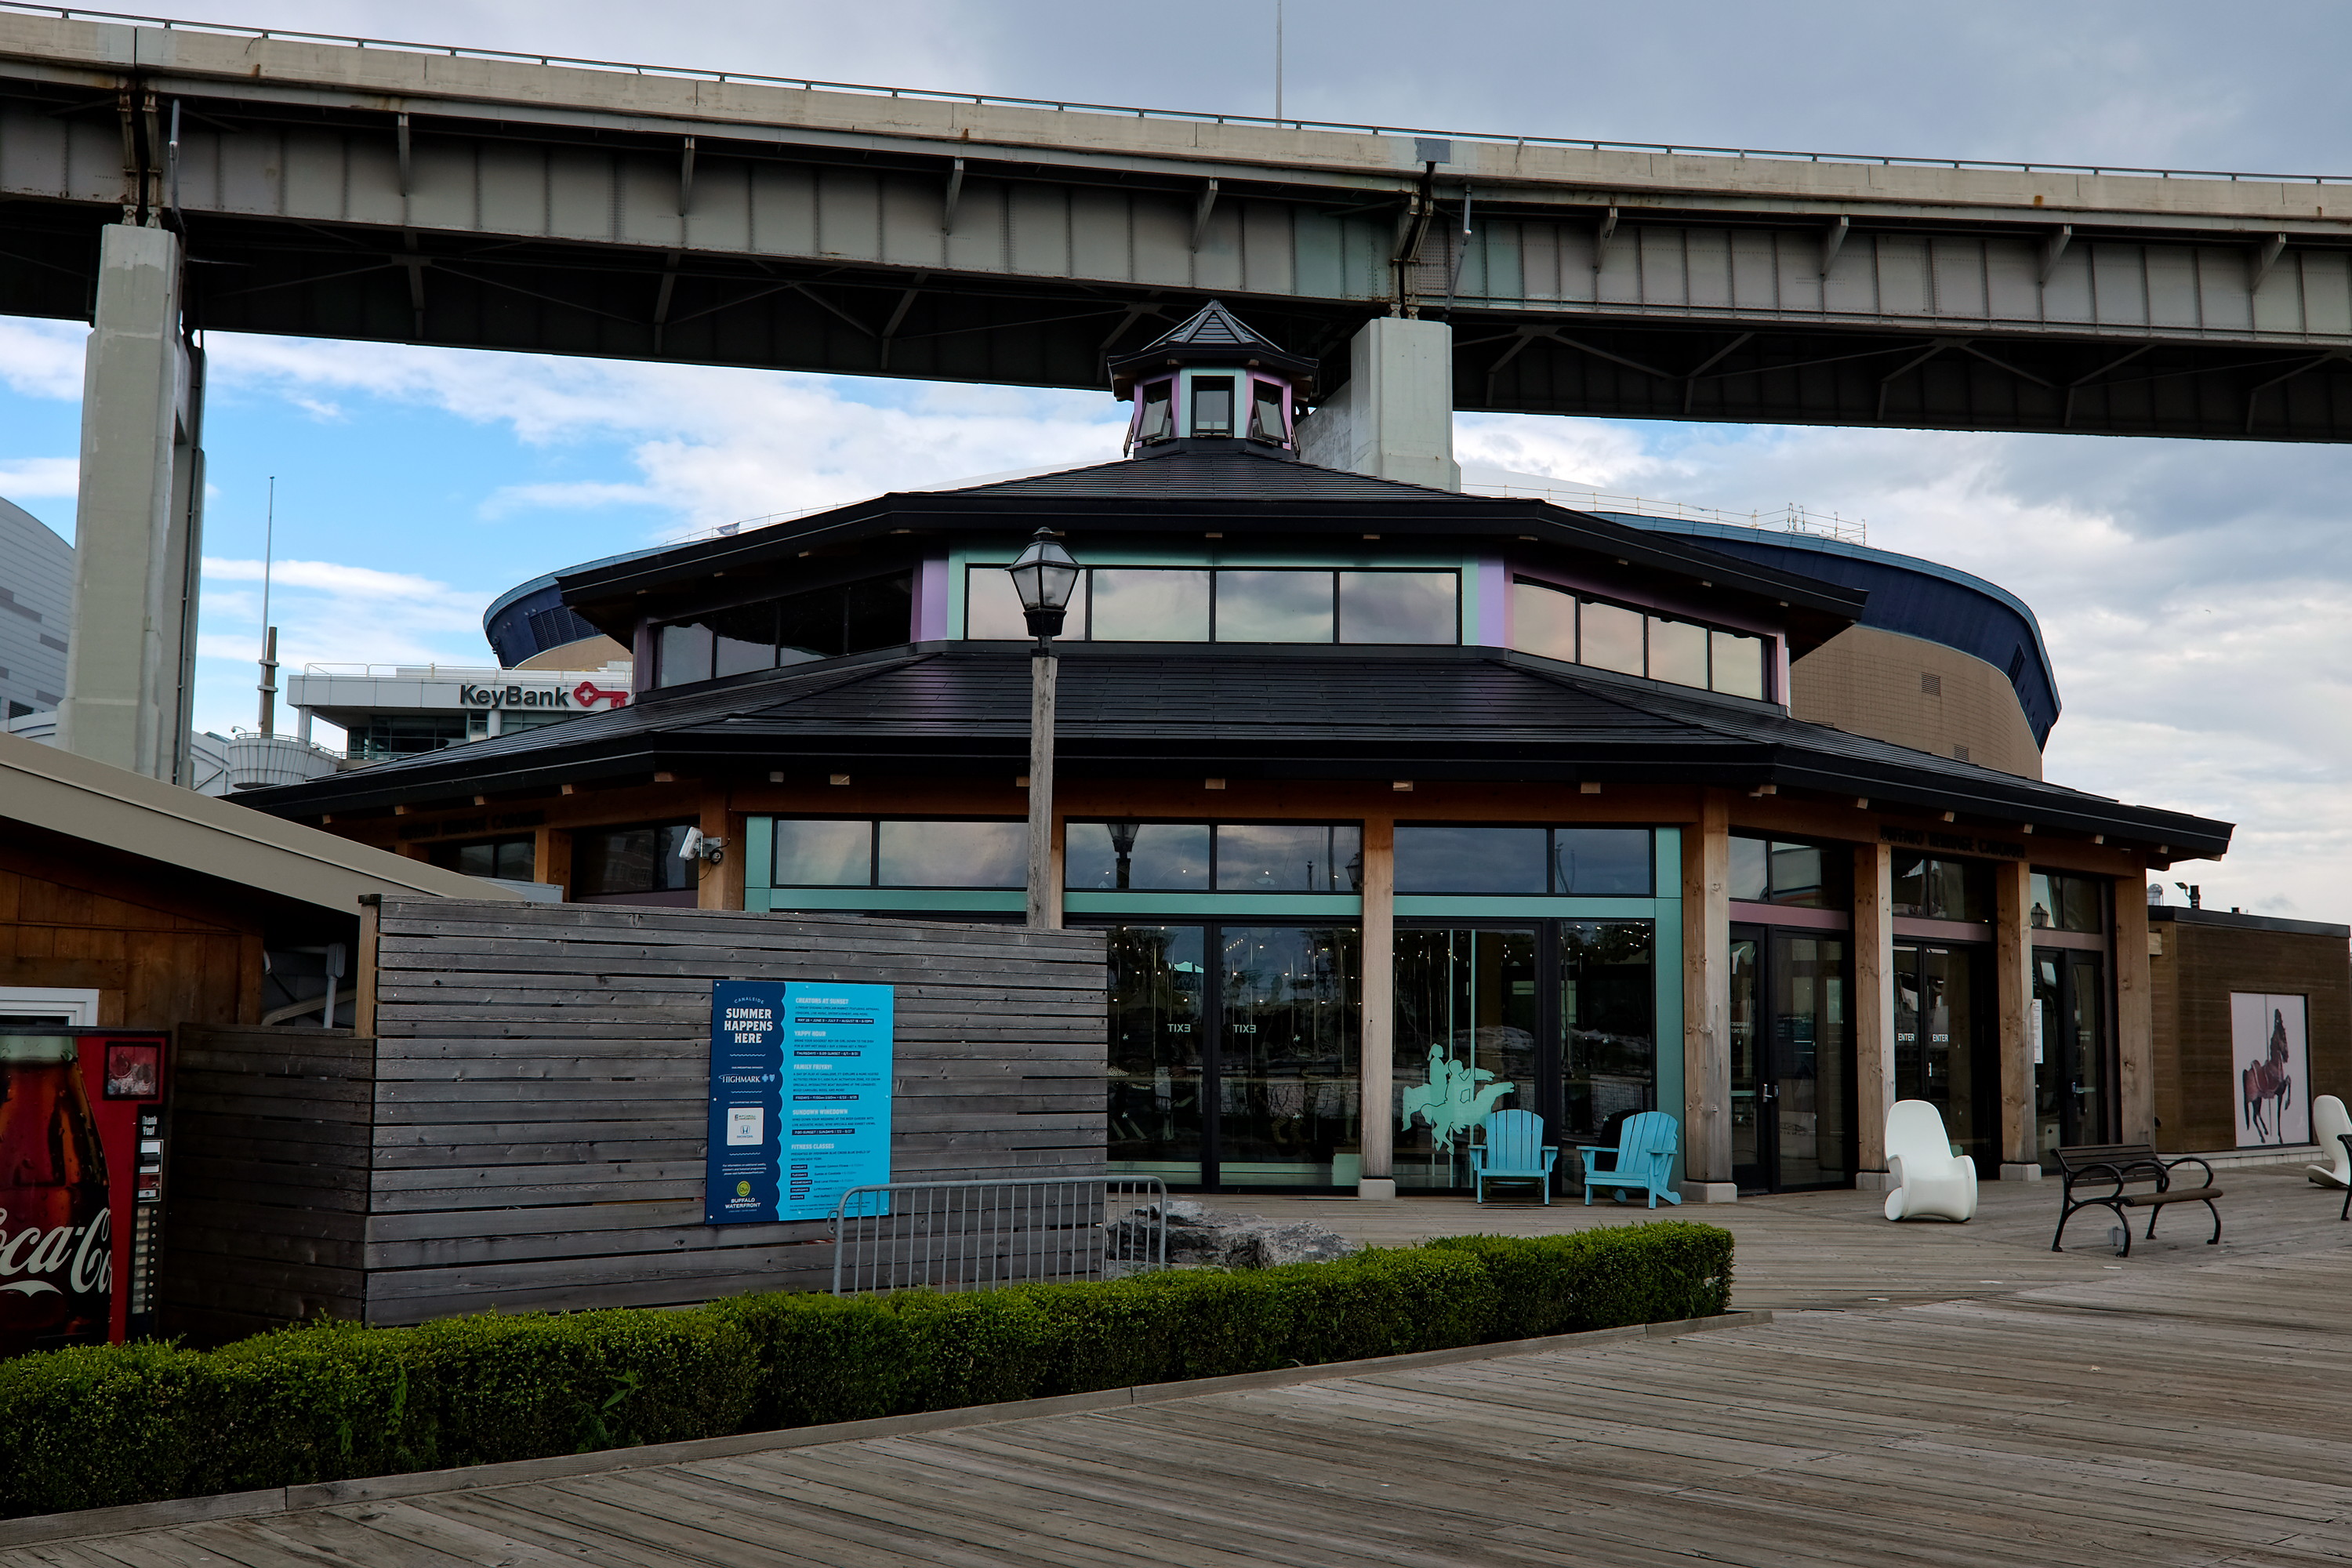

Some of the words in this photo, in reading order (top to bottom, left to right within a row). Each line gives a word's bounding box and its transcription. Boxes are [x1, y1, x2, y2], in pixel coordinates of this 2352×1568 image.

[460, 684, 570, 709] KeyBank
[726, 1008, 772, 1019] SUMMER
[724, 1020, 773, 1031] HAPPENS
[735, 1033, 762, 1044] HERE
[1897, 1033, 1915, 1042] ENTER
